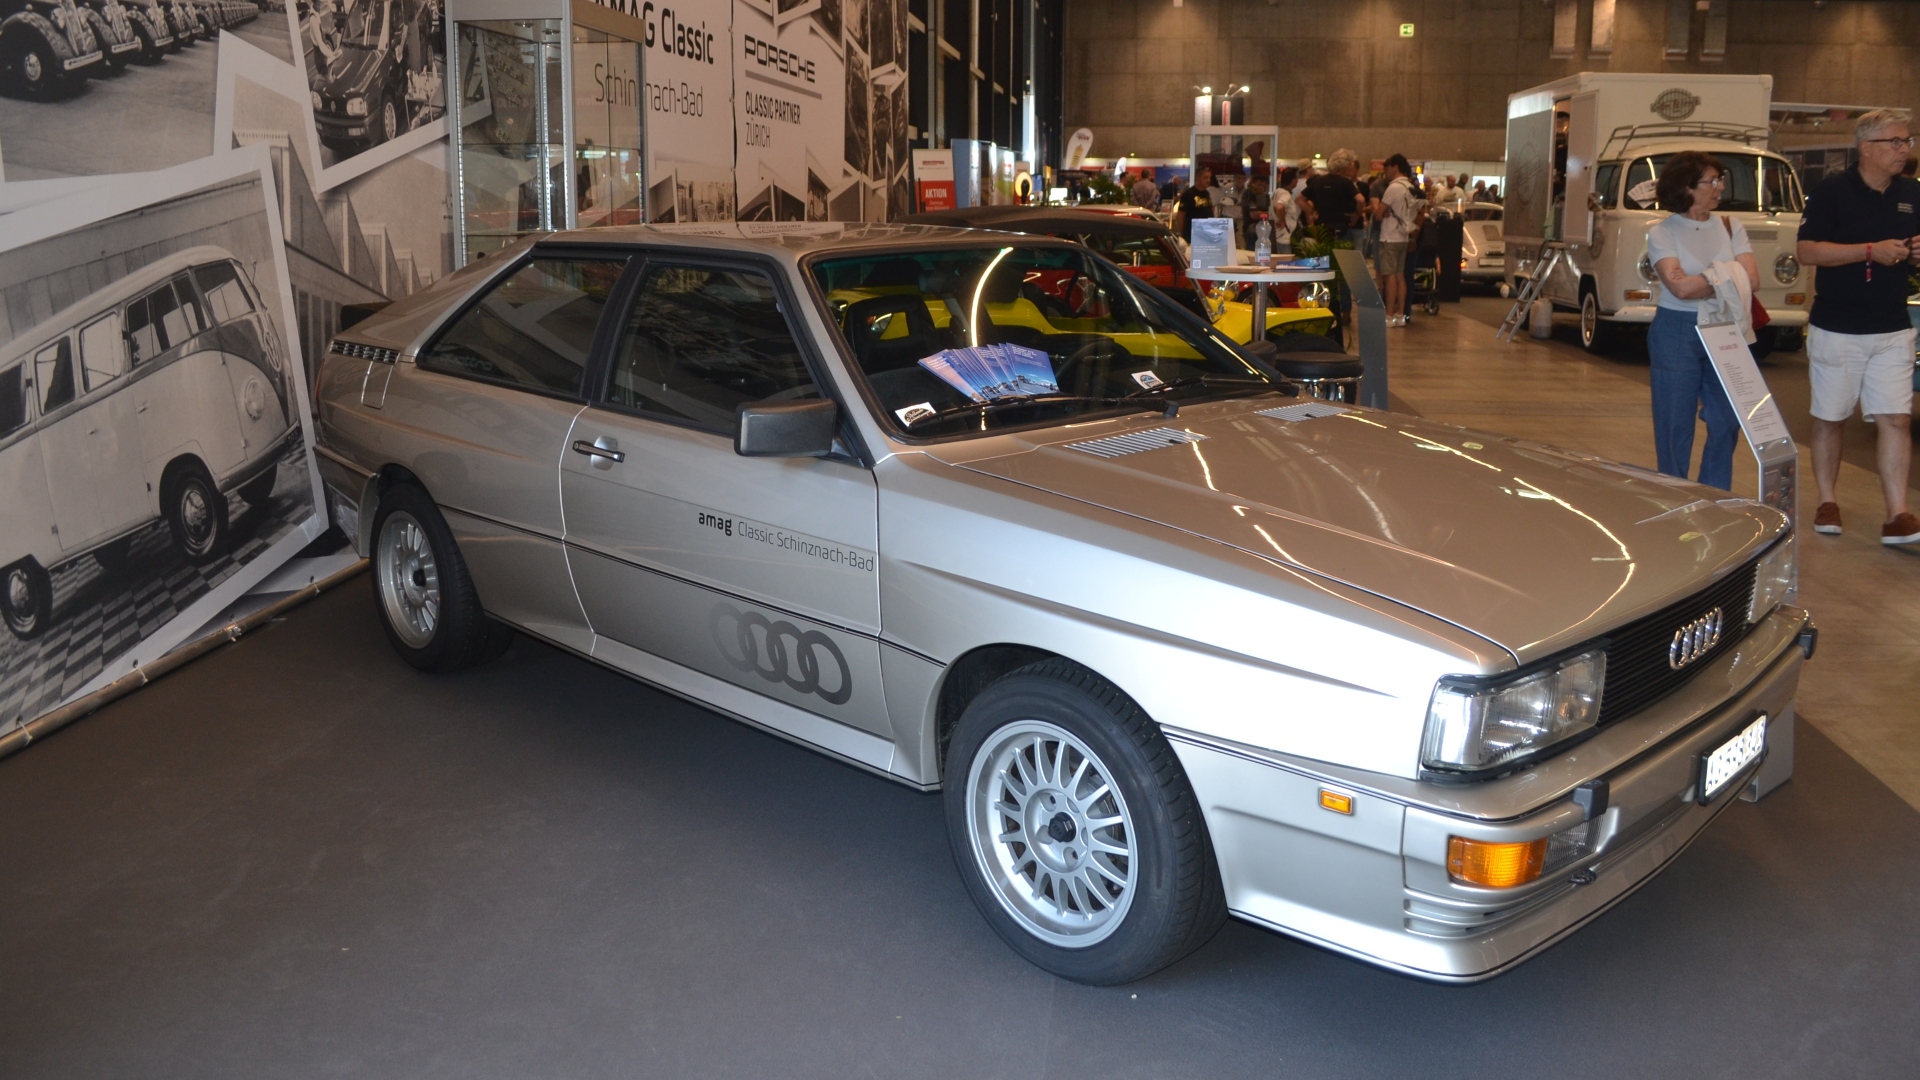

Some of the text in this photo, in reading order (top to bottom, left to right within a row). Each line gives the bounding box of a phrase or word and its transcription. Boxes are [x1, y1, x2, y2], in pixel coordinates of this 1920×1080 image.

[661, 8, 714, 65] Classic
[744, 34, 816, 84] PORSCHE
[594, 62, 703, 118] Schinnach-Bad
[745, 90, 801, 125] CLASSIC PARTNER
[745, 117, 771, 148] ZÜRICH
[925, 188, 947, 198] AKTION
[698, 512, 874, 572] amag Classic Schinznach-Bad
